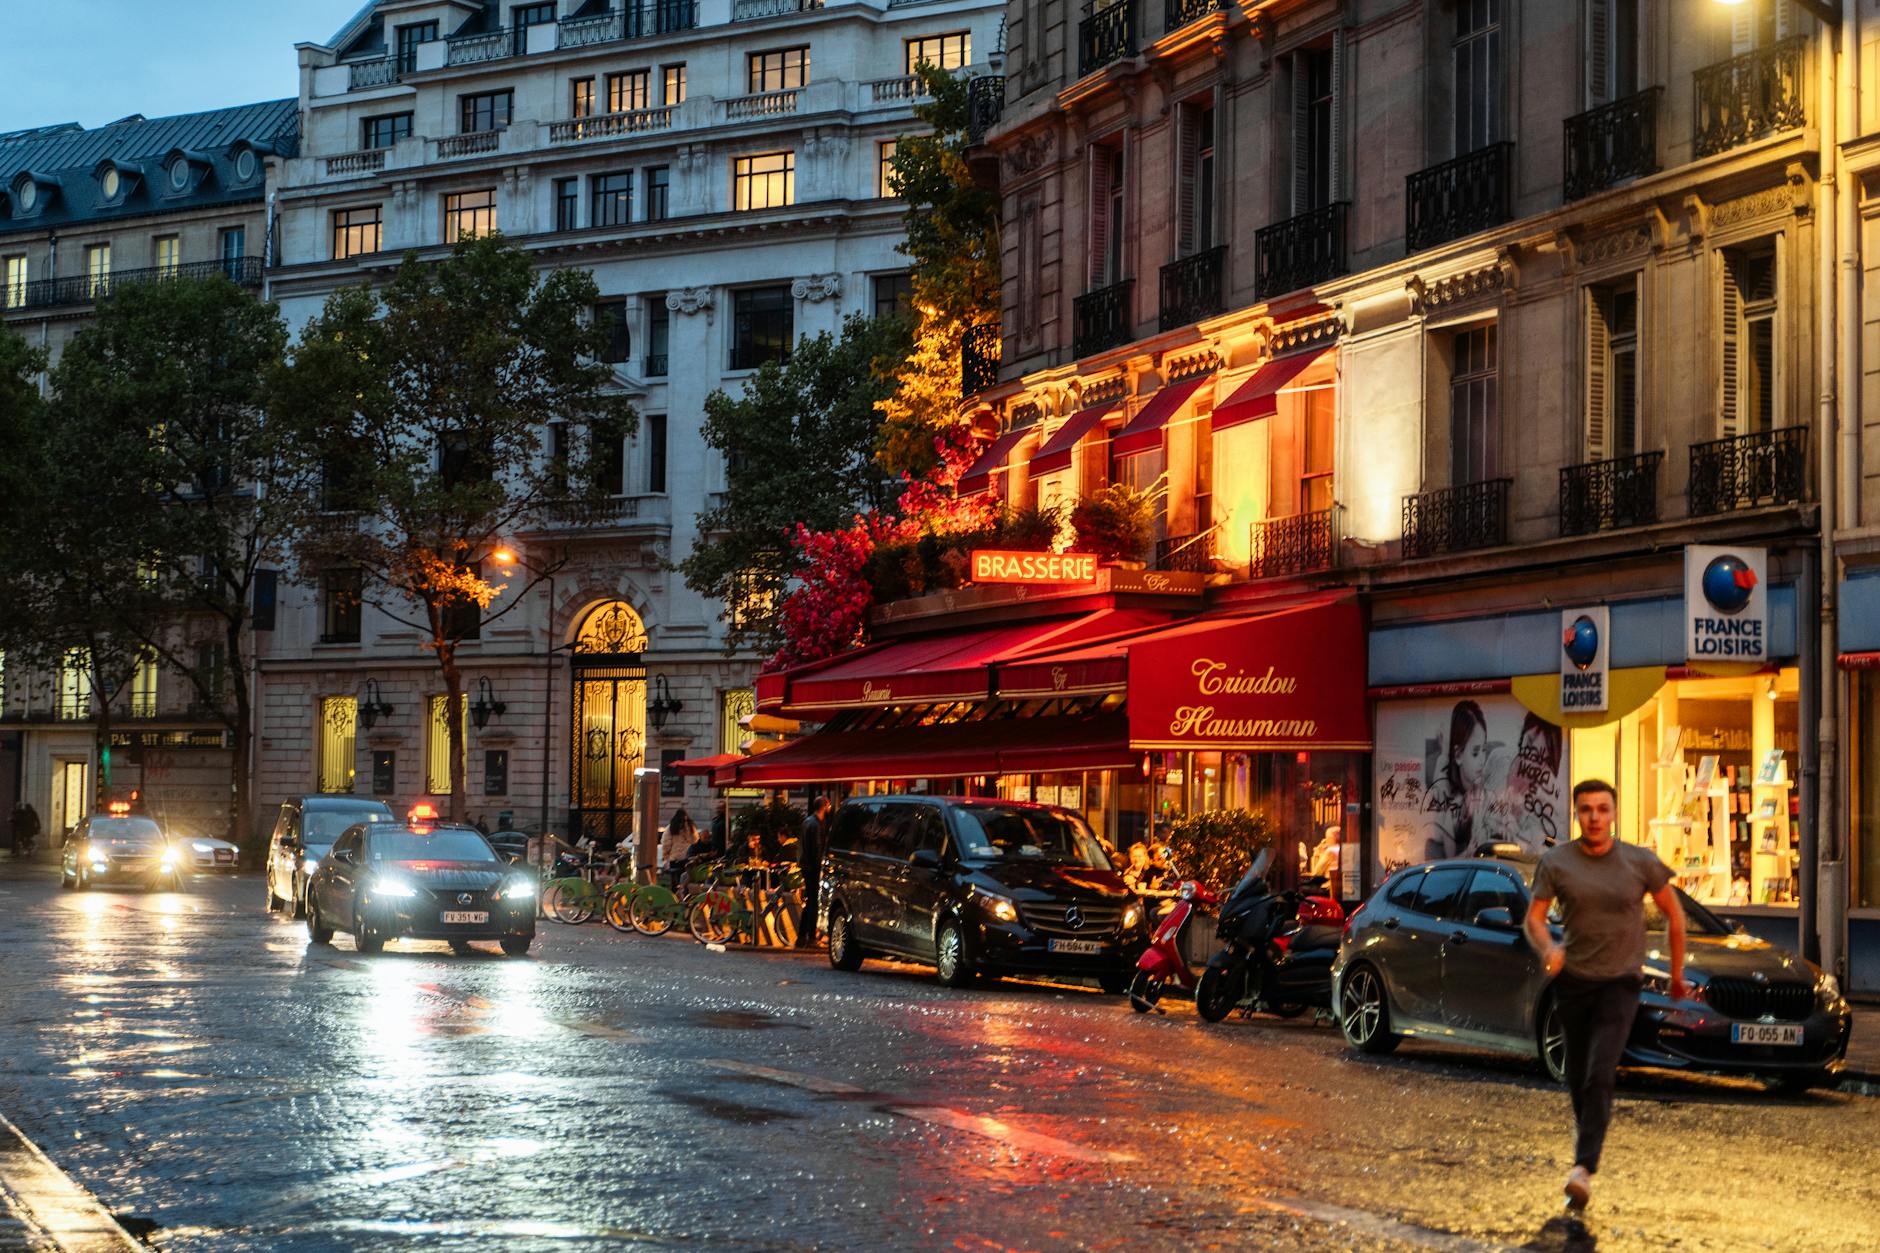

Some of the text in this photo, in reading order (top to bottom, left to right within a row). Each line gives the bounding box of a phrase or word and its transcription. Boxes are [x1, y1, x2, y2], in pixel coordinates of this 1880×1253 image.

[977, 555, 1095, 580] BRASSERIE
[1694, 618, 1762, 637] FRANCE
[1694, 638, 1762, 656] LOISIRS
[1191, 658, 1298, 696] Triadou
[1563, 672, 1602, 689] FRANCE
[1563, 690, 1602, 707] LOISIRS
[1170, 706, 1318, 737] Haussmann
